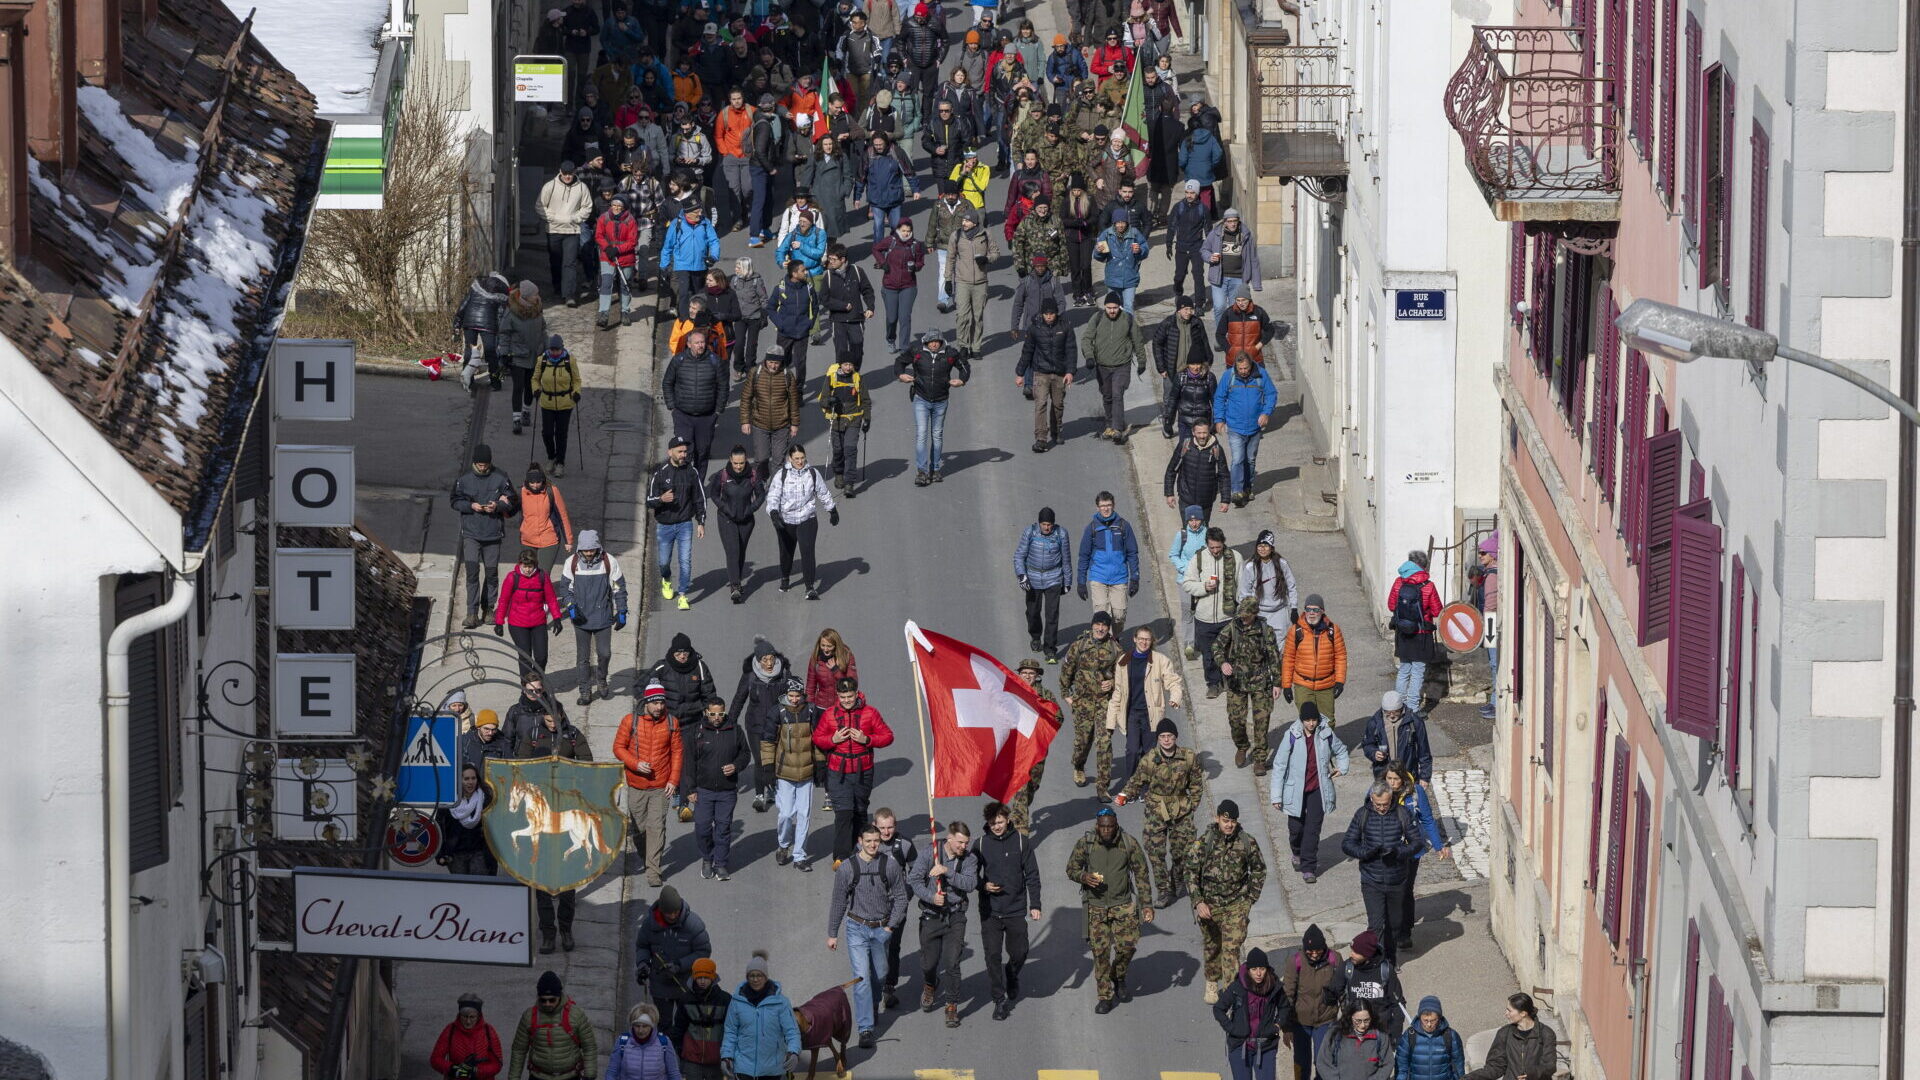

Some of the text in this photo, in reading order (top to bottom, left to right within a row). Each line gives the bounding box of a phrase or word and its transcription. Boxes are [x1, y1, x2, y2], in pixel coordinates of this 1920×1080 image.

[1413, 293, 1429, 301] RUE
[1398, 309, 1444, 317] LA CHAPELLE
[292, 361, 338, 822] HOTEL
